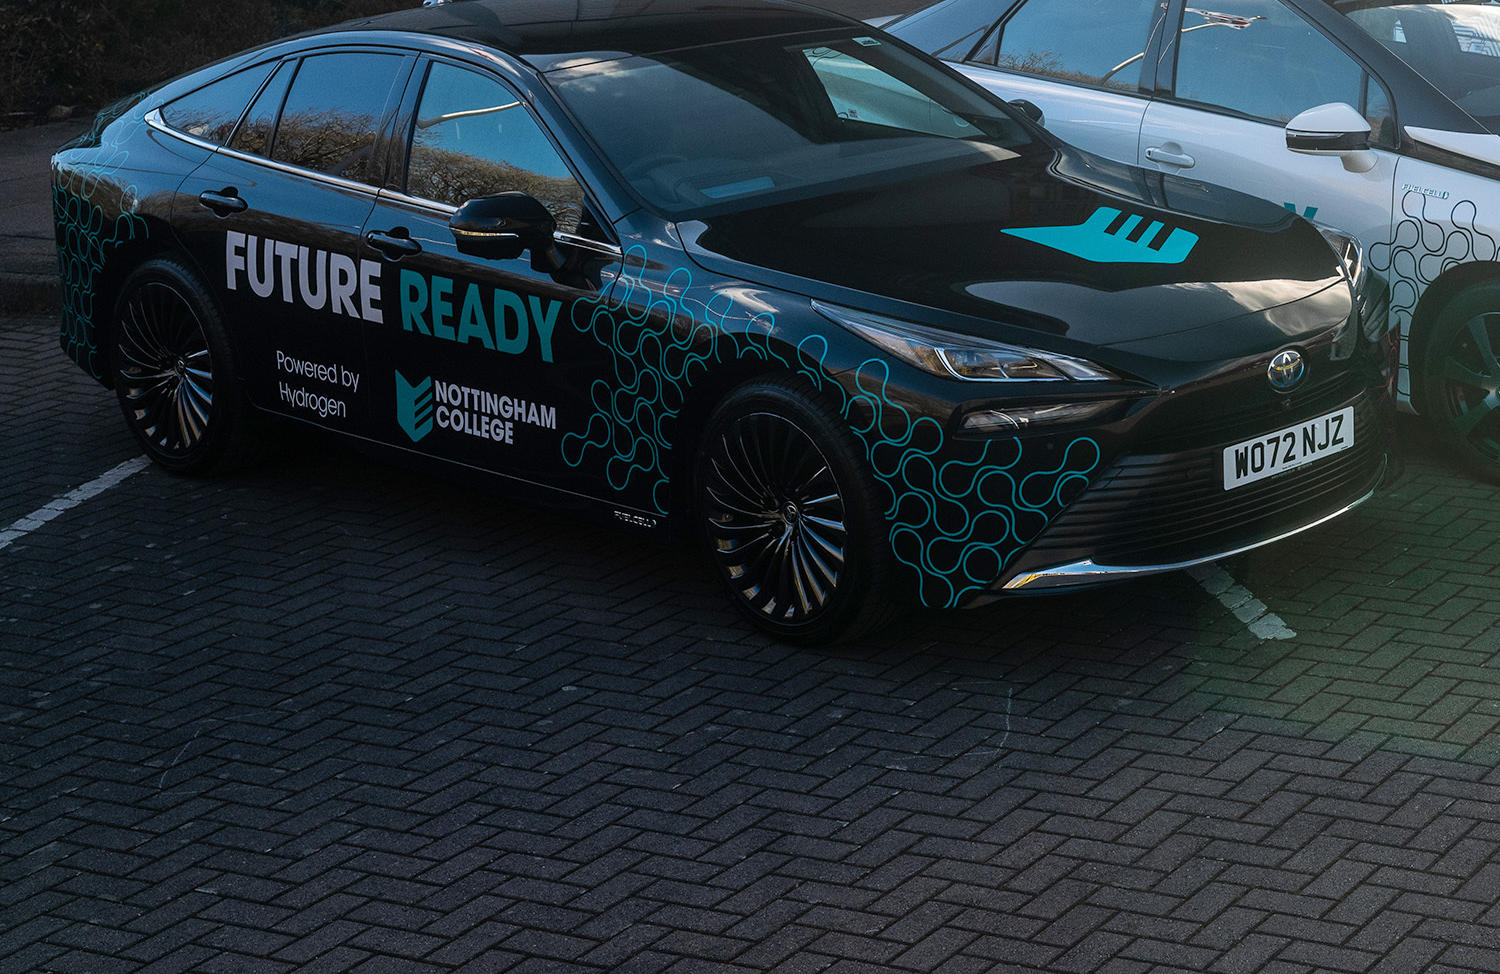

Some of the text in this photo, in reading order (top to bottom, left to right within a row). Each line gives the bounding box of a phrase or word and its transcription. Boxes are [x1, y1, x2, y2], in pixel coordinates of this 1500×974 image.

[225, 230, 563, 364] FUTURE READY
[276, 350, 360, 393] Powered by
[279, 381, 346, 418] Hydrogen
[434, 380, 557, 429] NOTTINGHAM
[435, 405, 514, 445] COLLEGE
[1234, 414, 1344, 480] WO72 NJZ
